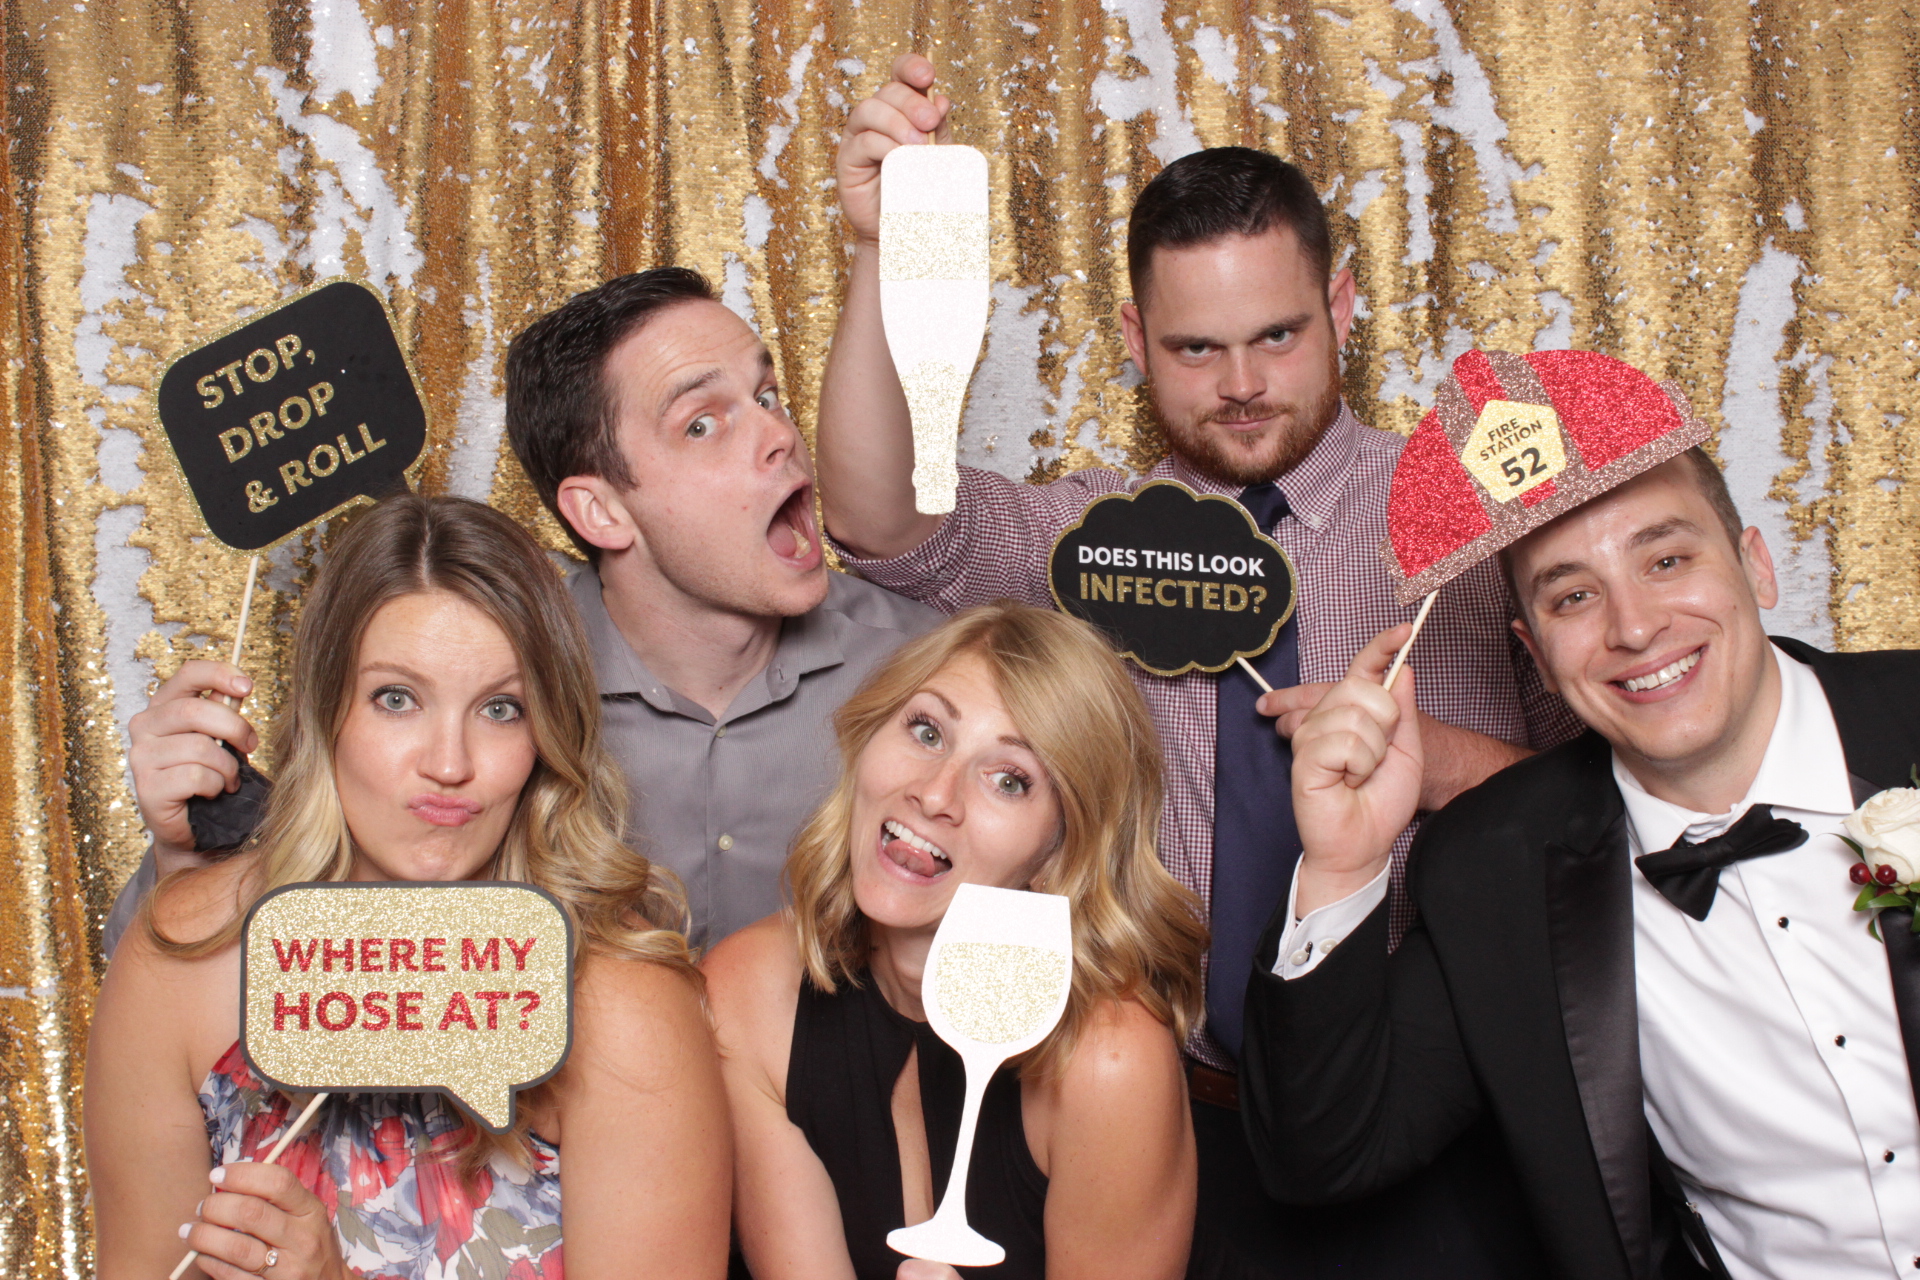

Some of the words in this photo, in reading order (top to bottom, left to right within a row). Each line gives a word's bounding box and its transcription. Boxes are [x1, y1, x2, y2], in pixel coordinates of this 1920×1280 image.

[196, 334, 316, 409] STOP,
[218, 381, 334, 464] DROP
[1480, 420, 1542, 461] STATION
[1488, 418, 1520, 441] FIRE
[245, 480, 279, 513] &
[279, 422, 387, 495] ROLL
[1500, 447, 1547, 487] 52
[1078, 545, 1138, 567] DOES
[1142, 550, 1193, 571] THIS
[1199, 554, 1265, 577] LOOK
[1080, 572, 1267, 613] INFECTED?
[271, 938, 446, 972] WHERE
[461, 937, 537, 971] MY
[273, 991, 424, 1031] HOSE
[438, 990, 541, 1031] AT?
